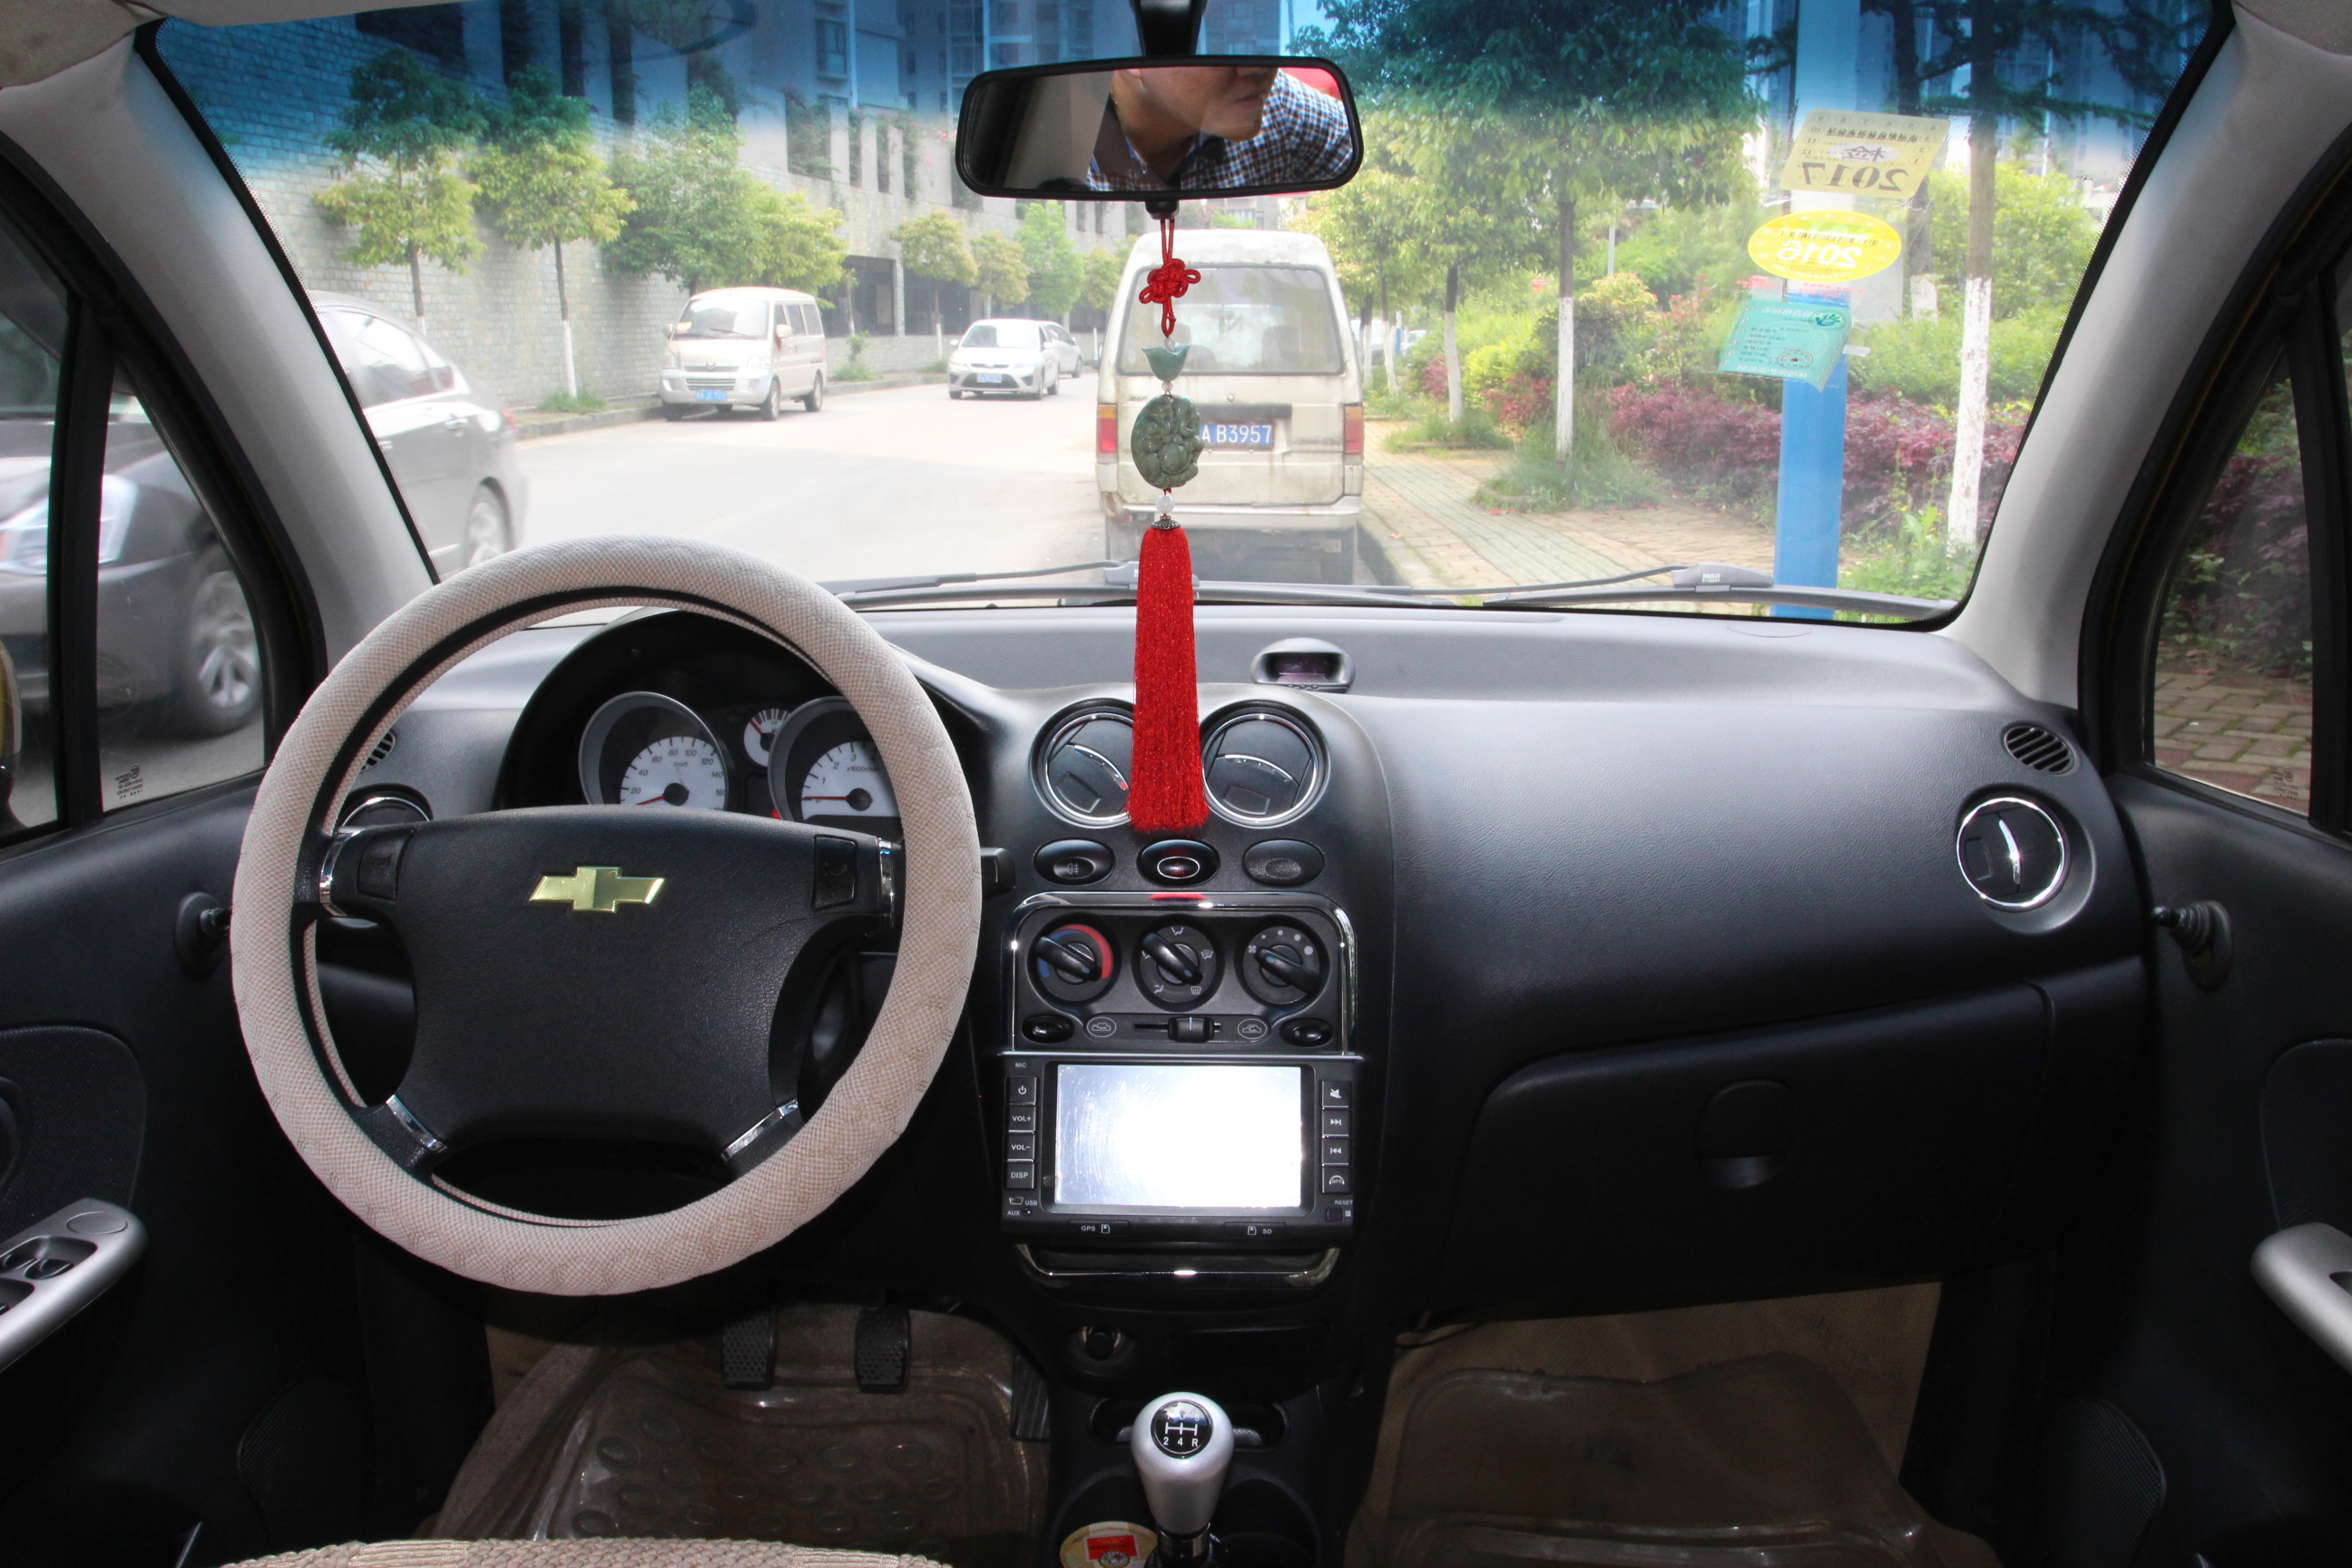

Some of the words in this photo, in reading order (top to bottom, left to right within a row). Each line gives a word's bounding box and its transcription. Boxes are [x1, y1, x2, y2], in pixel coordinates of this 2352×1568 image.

[1217, 425, 1271, 444] B3957
[631, 787, 642, 795] 20
[1163, 1436, 1170, 1446] 2
[1177, 1437, 1183, 1446] 4
[1191, 1438, 1199, 1447] R
